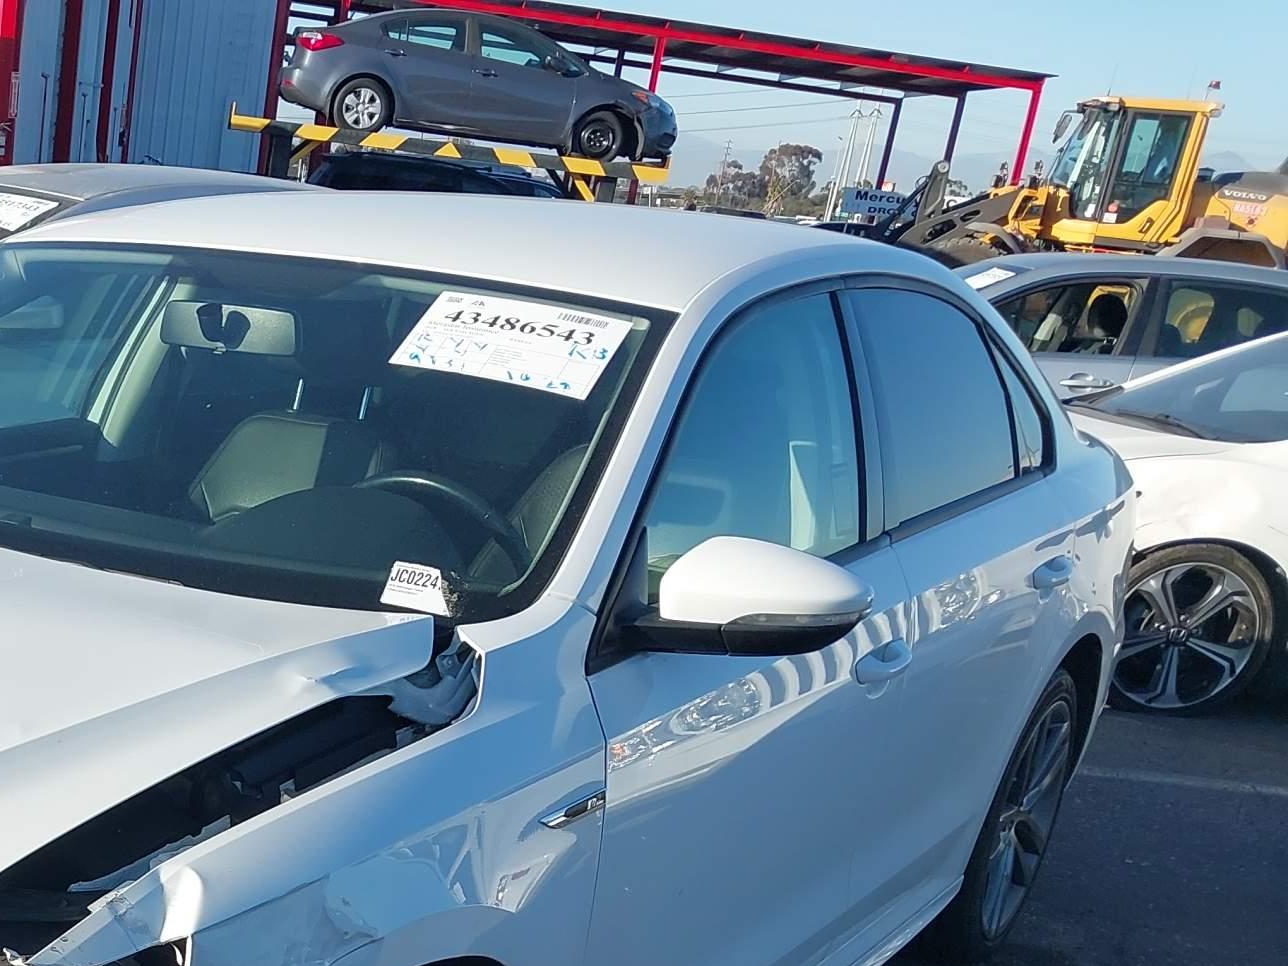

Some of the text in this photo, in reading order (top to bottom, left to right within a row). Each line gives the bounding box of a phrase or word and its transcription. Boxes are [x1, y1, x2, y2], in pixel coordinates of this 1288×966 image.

[1223, 188, 1268, 201] VOLVO
[444, 310, 595, 345] 43486543
[390, 567, 441, 591] JC0224
